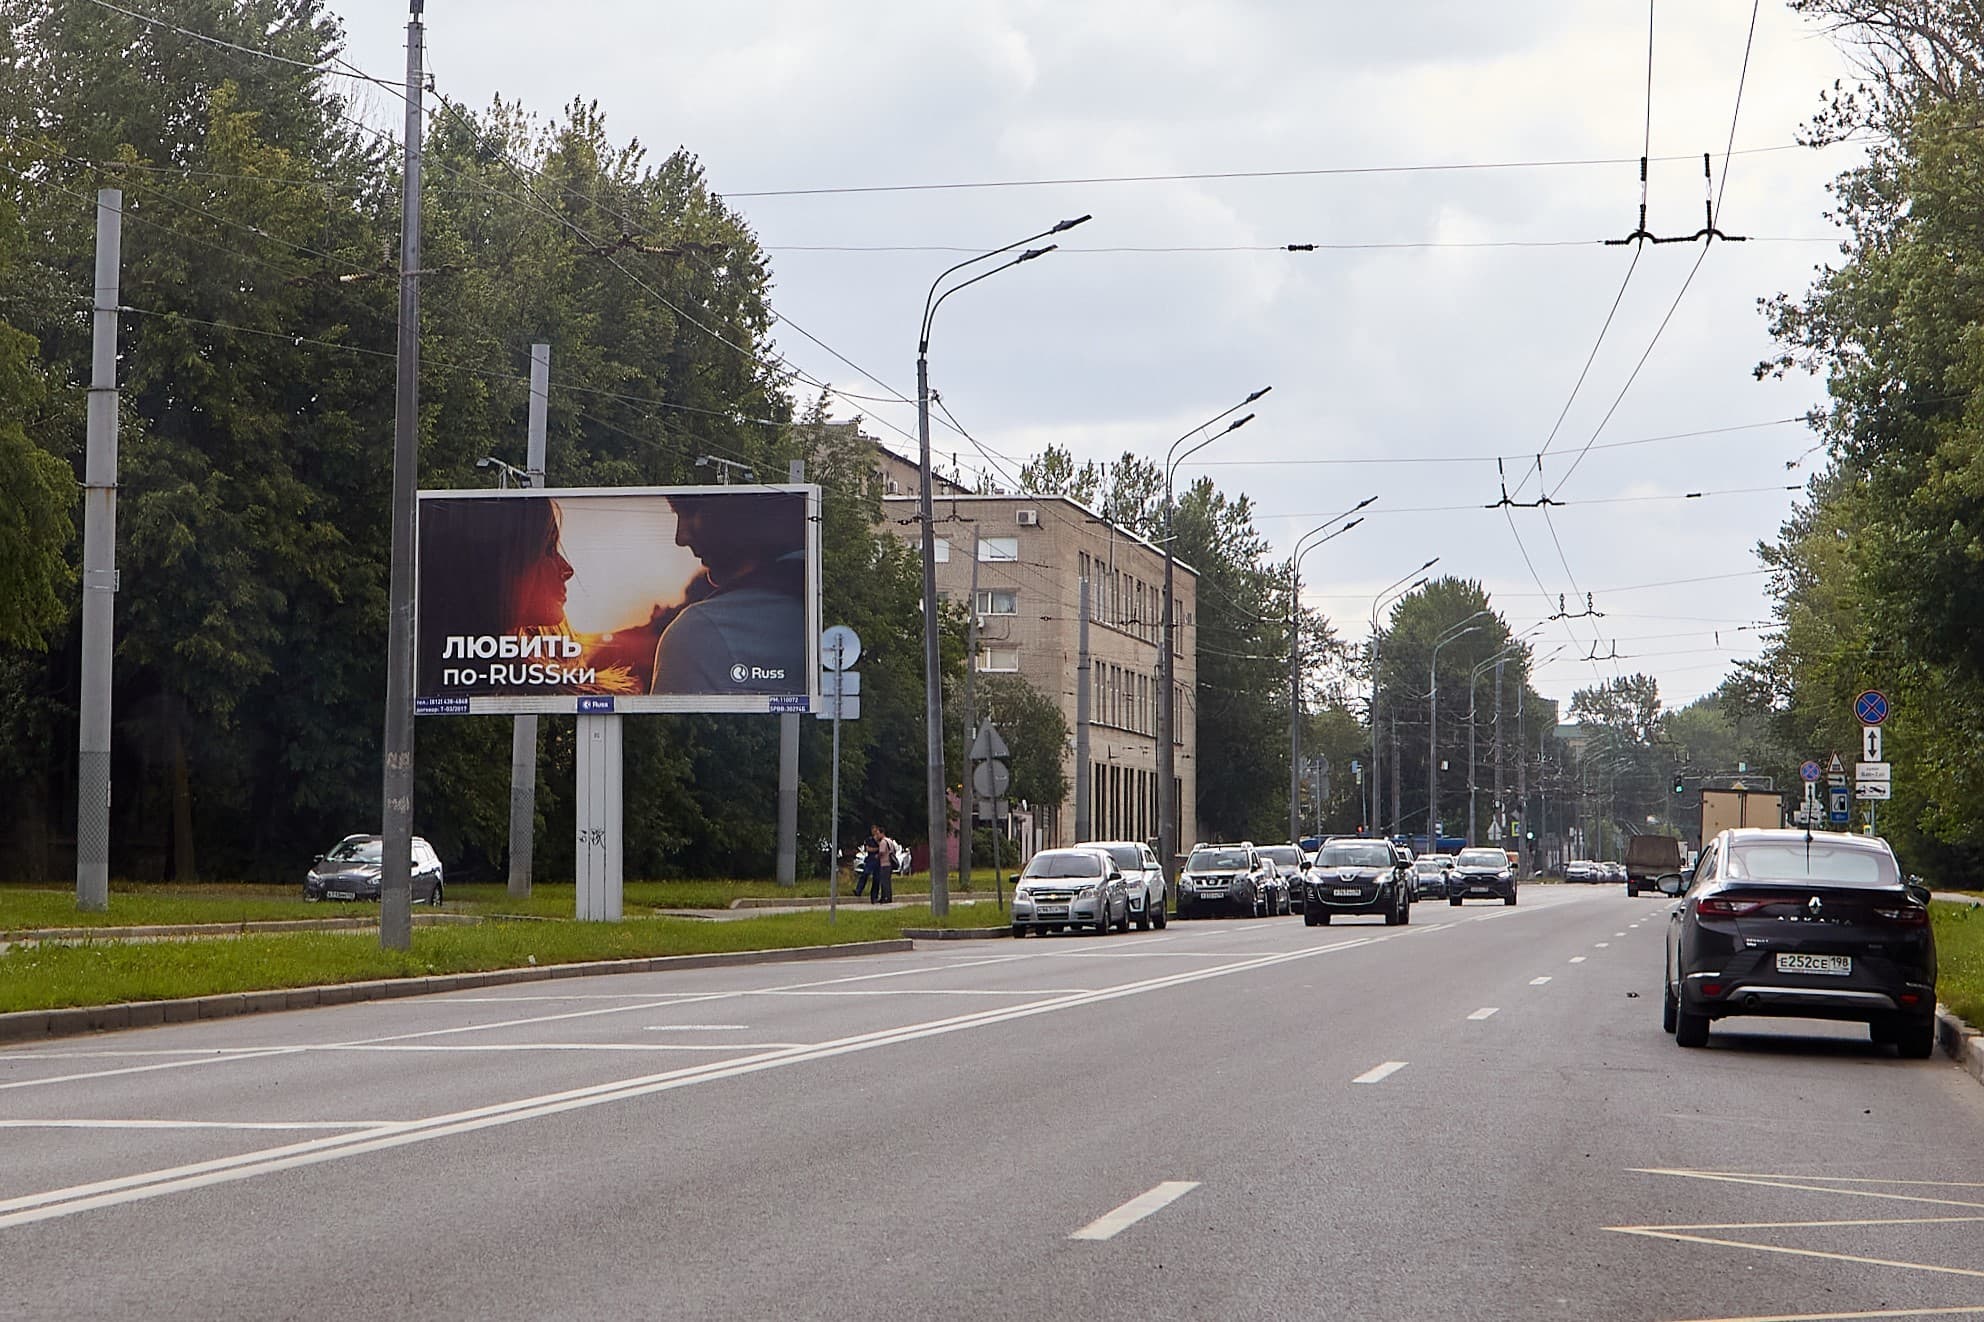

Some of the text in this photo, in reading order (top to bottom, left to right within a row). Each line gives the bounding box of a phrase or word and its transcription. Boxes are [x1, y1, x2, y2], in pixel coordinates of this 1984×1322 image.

[442, 635, 582, 659] ЛЮБИТЬ
[443, 663, 595, 685] по-RUSSки
[751, 666, 785, 679] Russ
[592, 700, 609, 709] Russ
